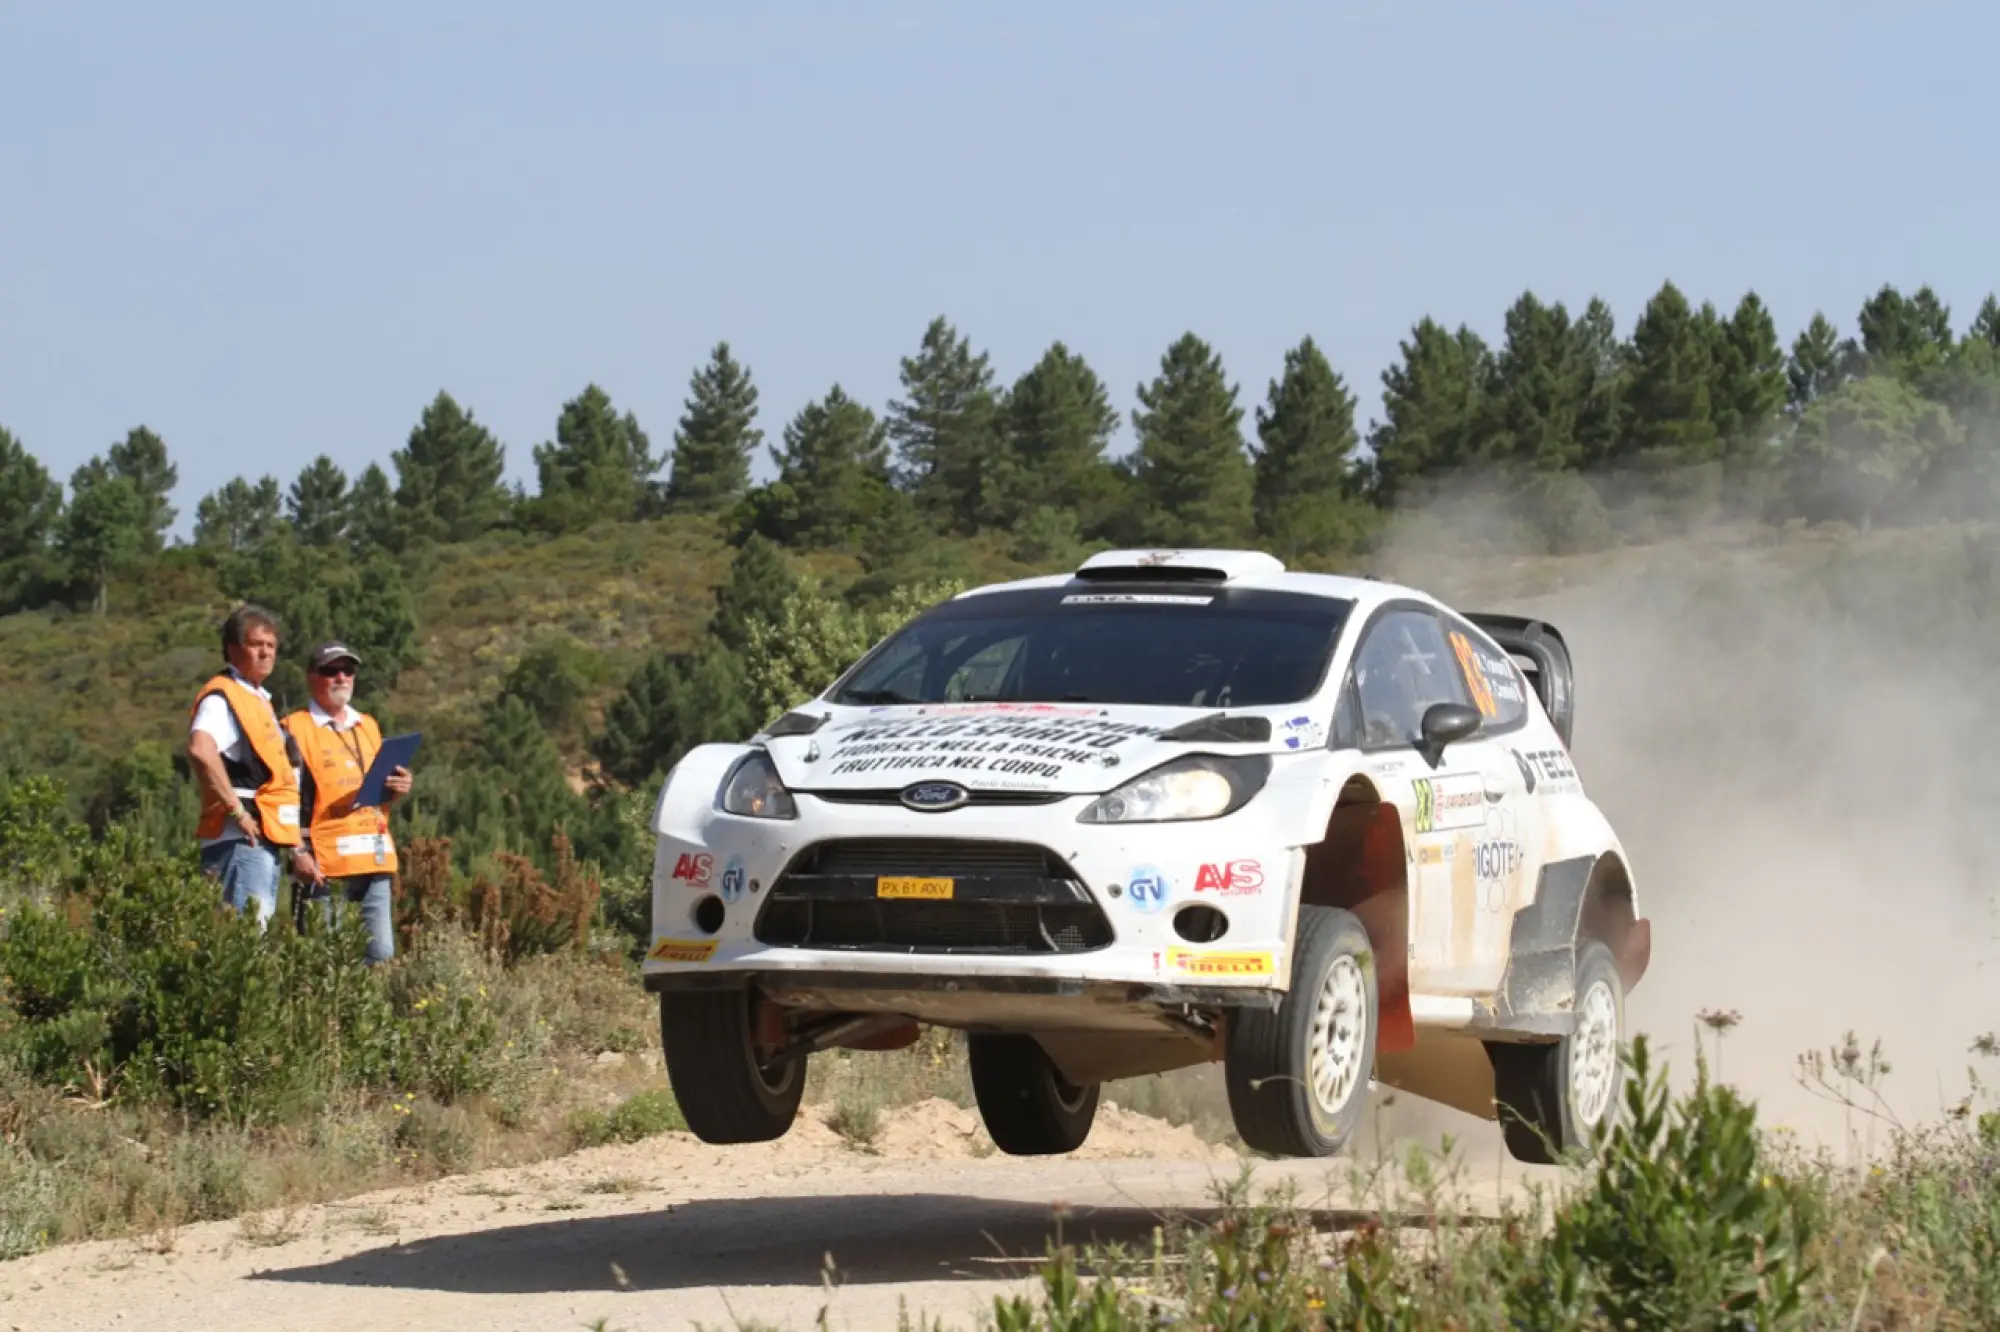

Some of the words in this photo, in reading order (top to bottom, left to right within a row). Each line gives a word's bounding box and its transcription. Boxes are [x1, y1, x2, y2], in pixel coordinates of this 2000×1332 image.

[838, 724, 968, 744] NELLO
[964, 724, 1129, 749] SPIRITO
[933, 740, 1010, 753] NELLA
[1008, 742, 1099, 763] PSICHE
[831, 755, 949, 775] FRUTTIFICA
[947, 755, 987, 770] NEL
[987, 758, 1063, 780] CORPO.
[913, 787, 951, 801] Ford
[672, 852, 714, 883] AVS
[1193, 859, 1265, 892] AVS
[881, 881, 900, 895] PX
[902, 881, 917, 895] 61
[921, 881, 949, 895] AXV
[1176, 952, 1264, 973] PIRELLI
